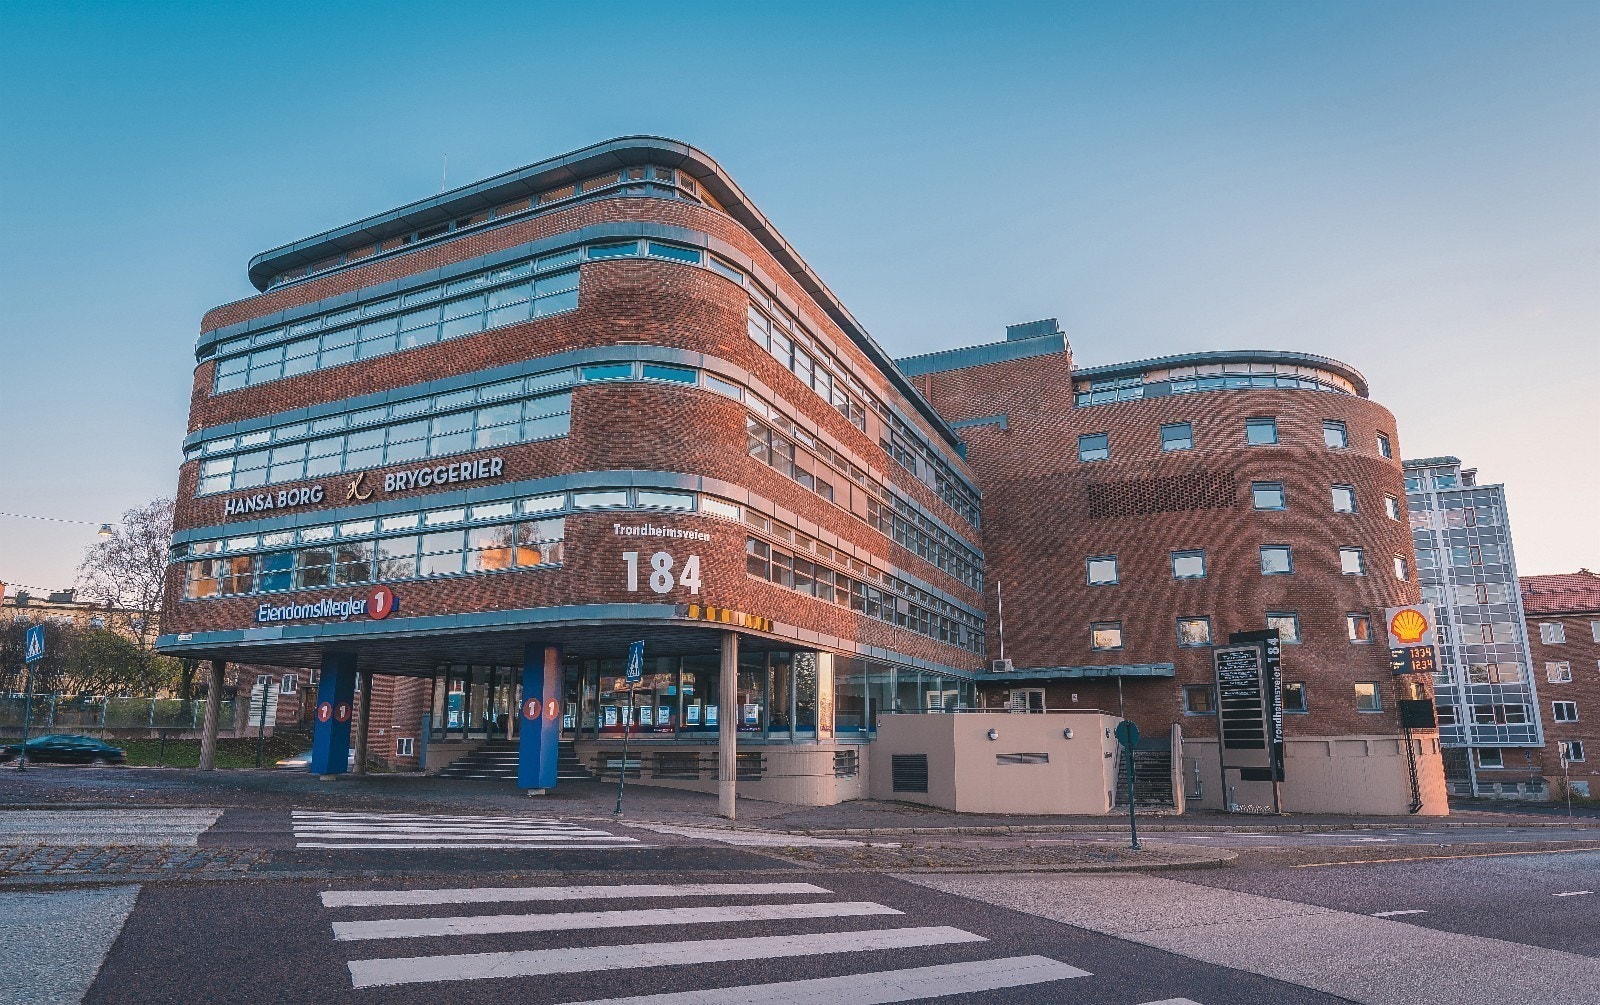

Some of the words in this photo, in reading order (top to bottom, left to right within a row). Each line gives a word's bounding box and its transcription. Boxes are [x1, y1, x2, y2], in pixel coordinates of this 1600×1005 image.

[225, 493, 273, 516] HANSA
[278, 485, 324, 508] BORG
[384, 457, 503, 492] BRYGGERIER
[613, 523, 711, 541] Trondheimsveien
[622, 551, 702, 595] 184
[258, 595, 367, 622] EiendomsMegler
[374, 591, 385, 613] 1
[1267, 637, 1280, 663] 184
[1271, 666, 1283, 744] Trondheimsveien
